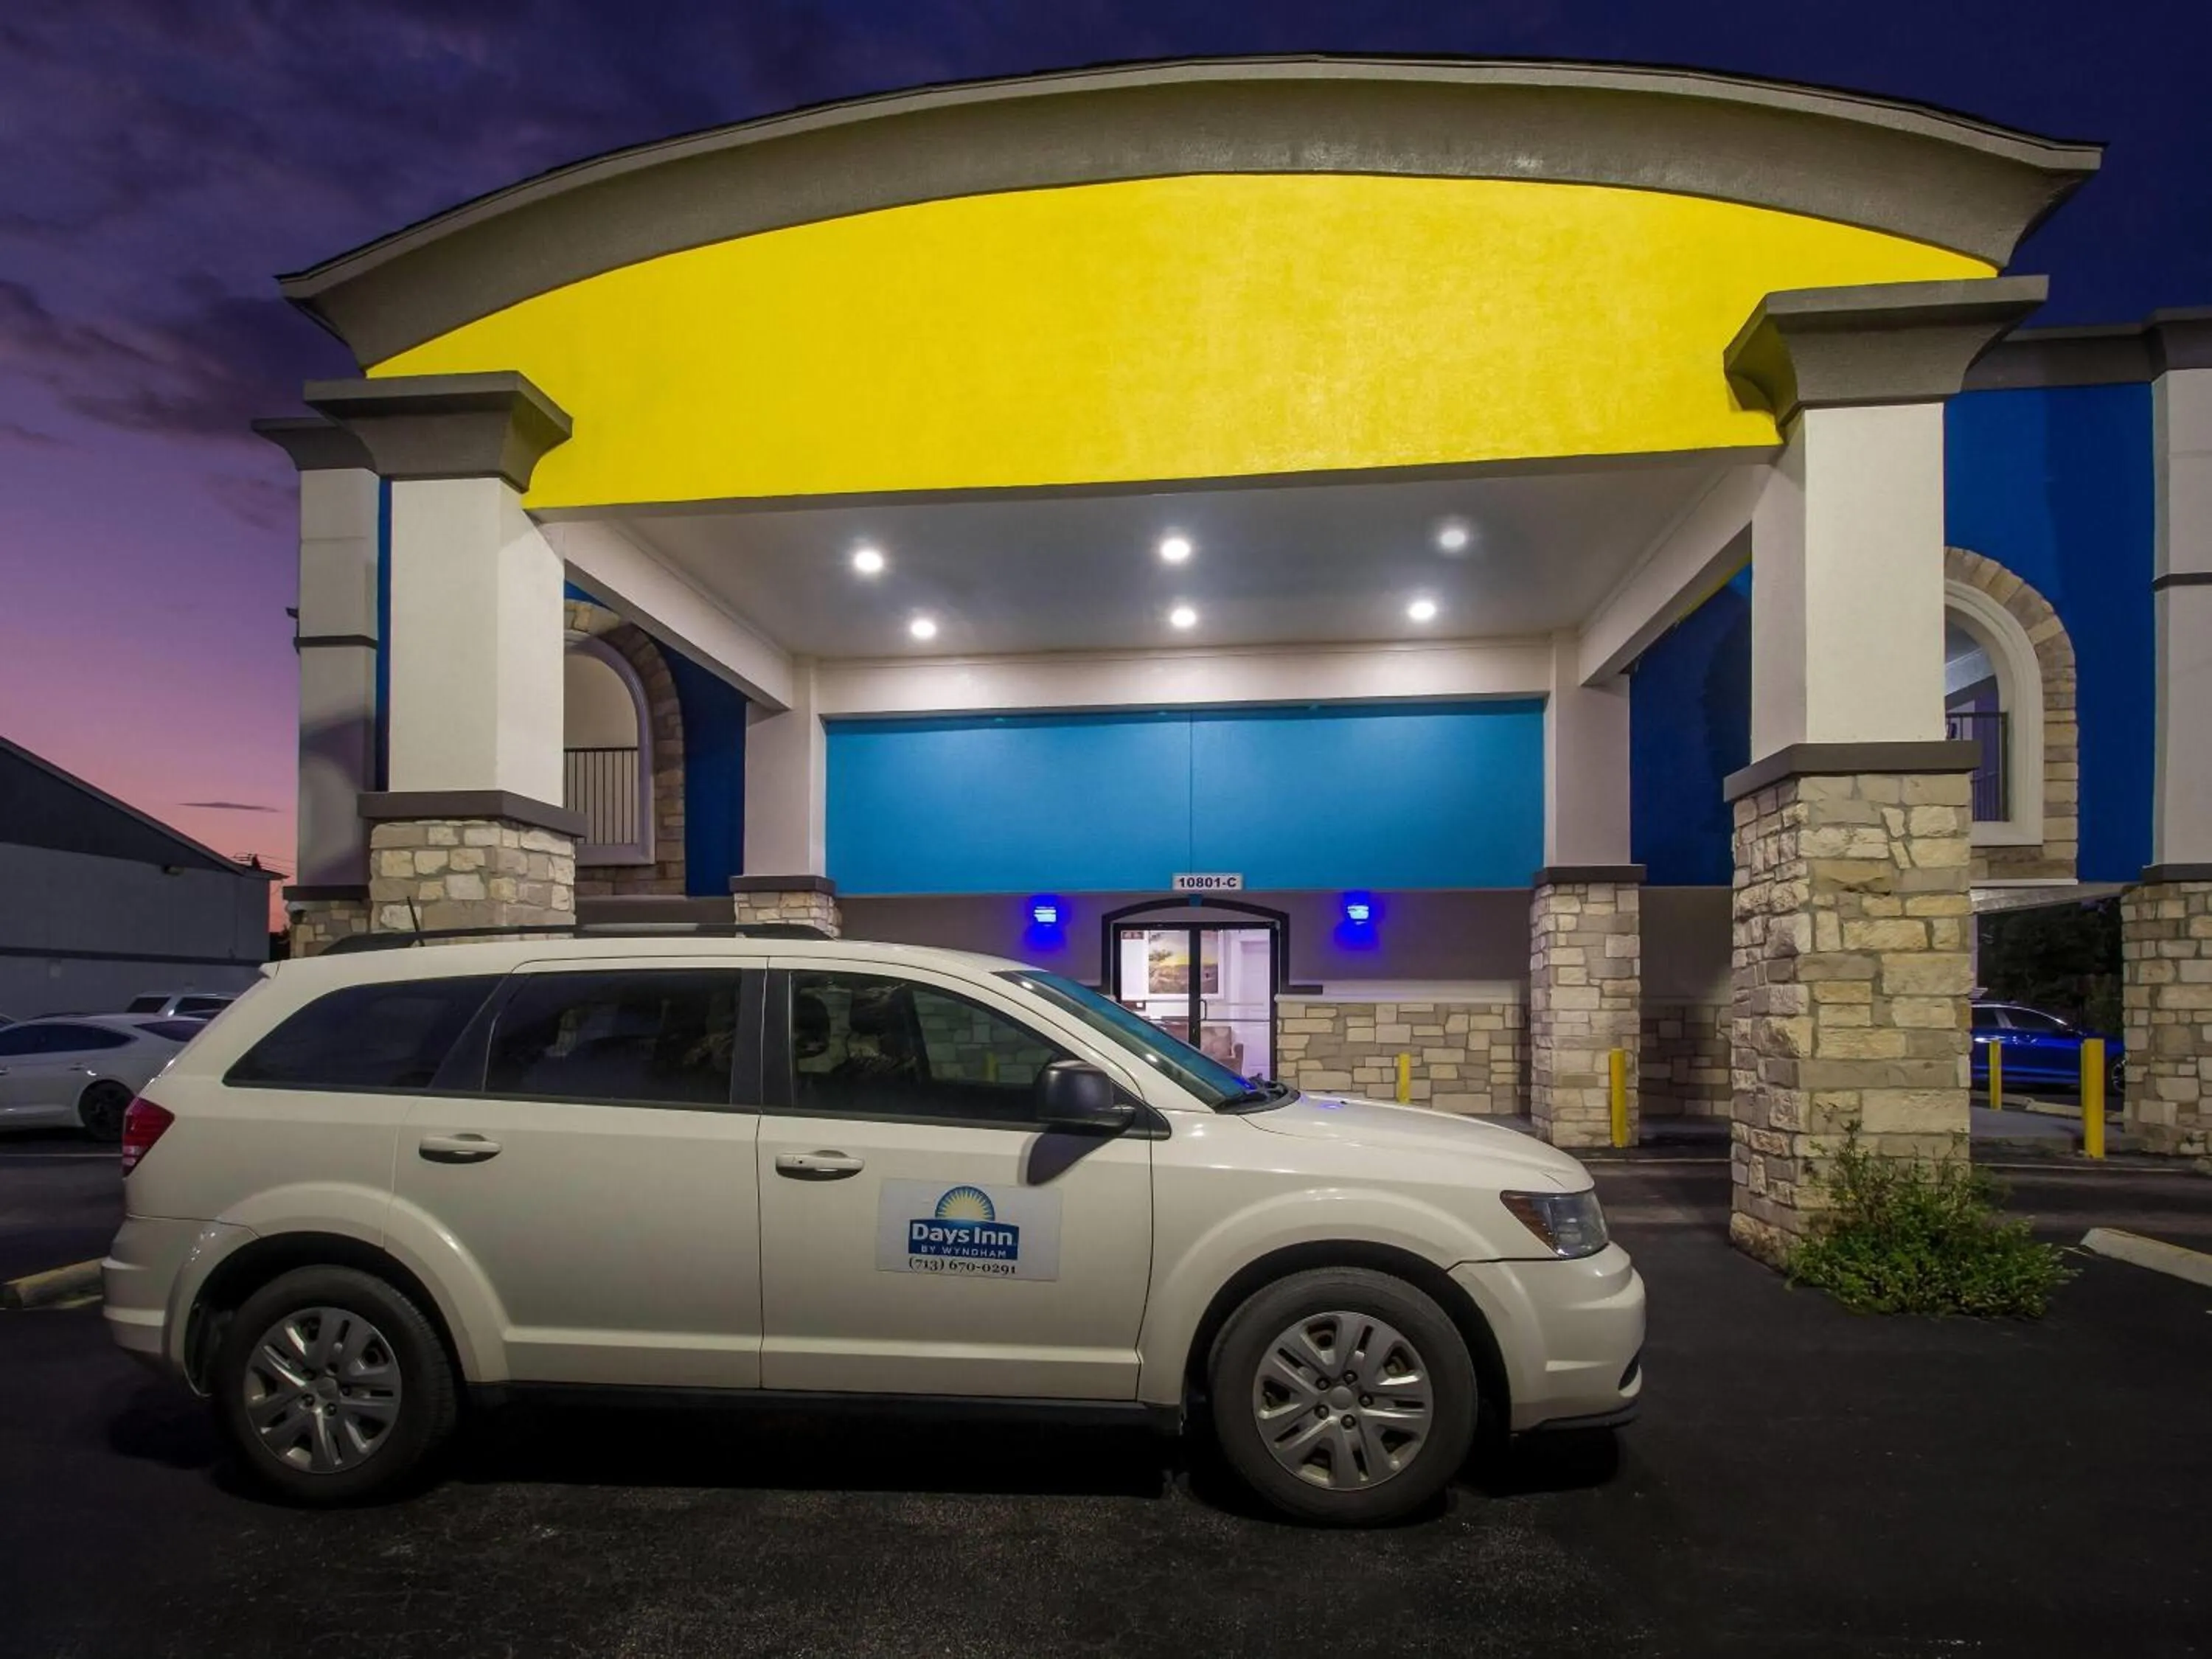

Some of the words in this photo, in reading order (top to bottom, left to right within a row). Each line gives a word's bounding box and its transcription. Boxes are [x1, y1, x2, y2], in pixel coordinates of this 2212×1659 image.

[1180, 877, 1237, 888] 10801-C
[912, 1222, 970, 1245] Days
[974, 1226, 1012, 1245] Inn
[921, 1244, 936, 1253] BY
[942, 1246, 1006, 1259] WYNDHAM
[908, 1256, 945, 1271] (713)
[949, 1259, 1016, 1275] 670-0291
